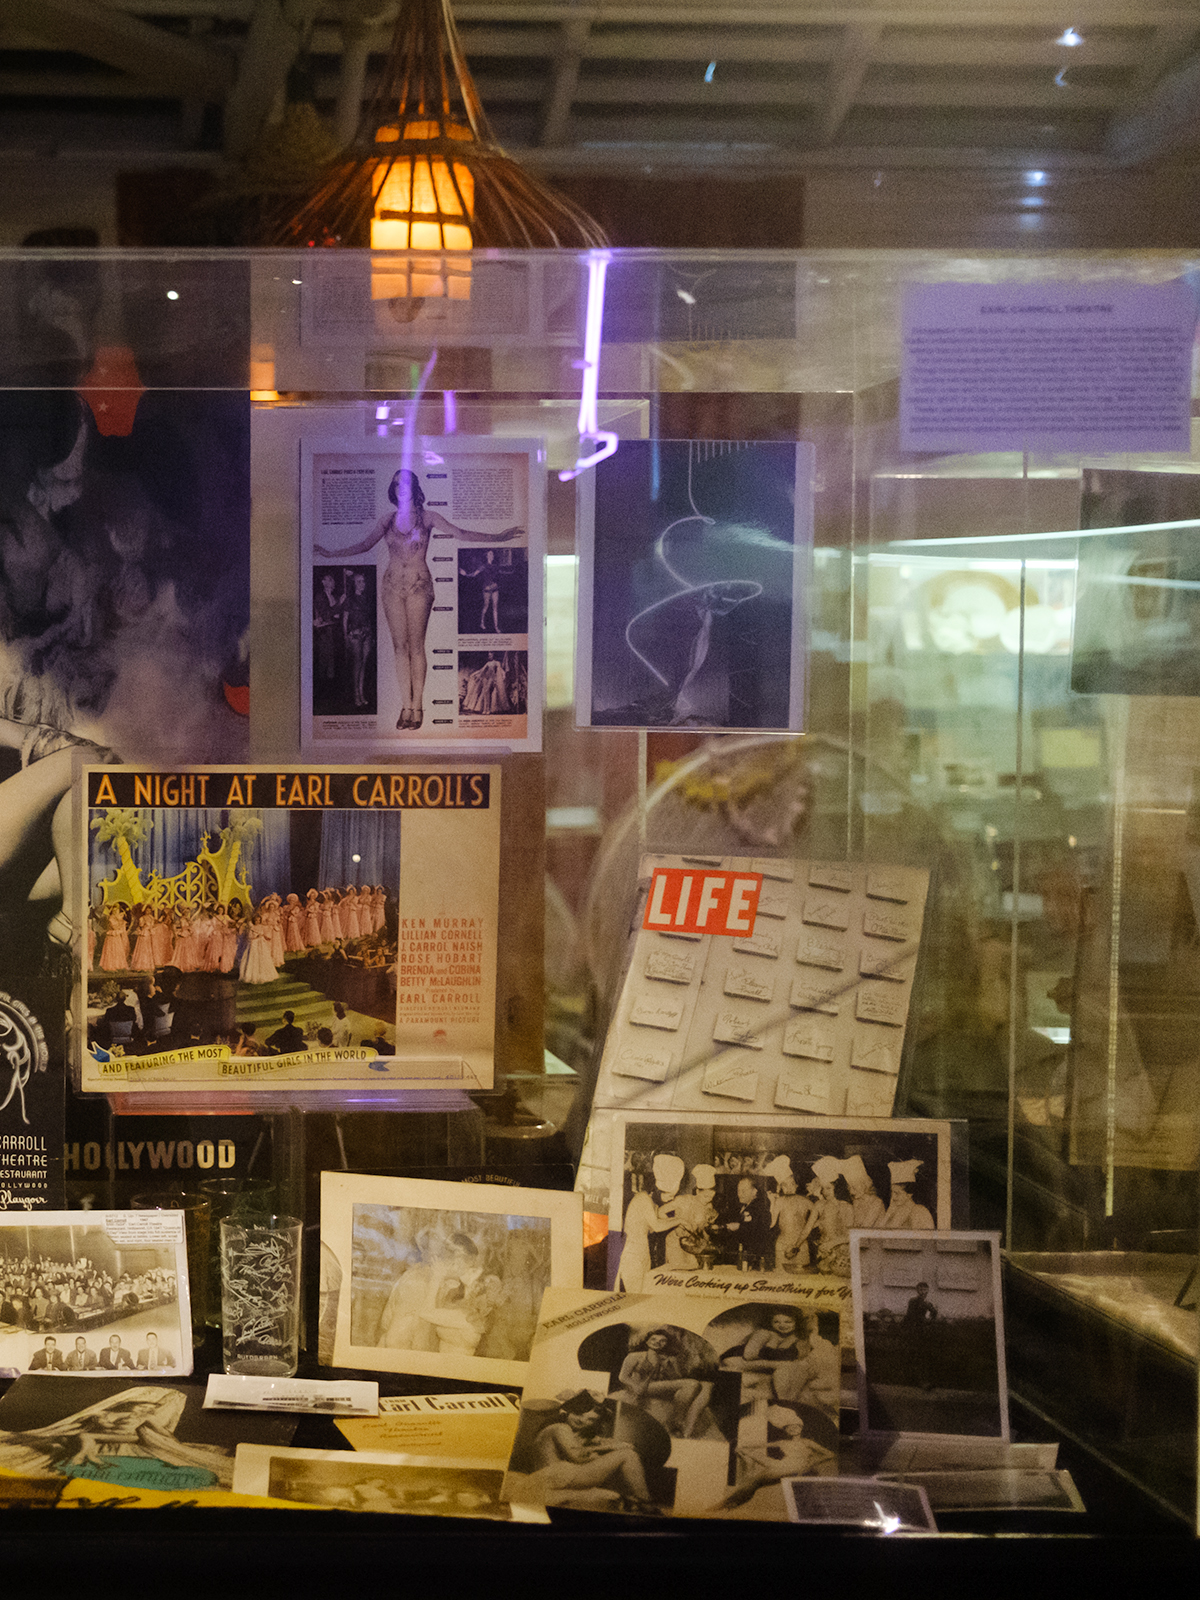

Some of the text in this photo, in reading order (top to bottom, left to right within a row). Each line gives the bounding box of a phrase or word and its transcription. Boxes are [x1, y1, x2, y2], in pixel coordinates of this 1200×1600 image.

[94, 774, 483, 807] A NIGHT AT EARL CARROLL'S
[648, 874, 758, 930] LIFE
[401, 918, 483, 929] KEN MURRAY
[401, 930, 483, 940] LILLIAN CORNELL
[409, 942, 448, 952] CARROL
[452, 942, 483, 952] NAISH
[400, 953, 482, 963] ROSE HOBART
[400, 965, 435, 975] BRENDA
[400, 977, 426, 987] BETTY
[400, 993, 481, 1003] EARL CARROLL
[11, 1000, 31, 1017] GIRLS
[27, 1016, 38, 1025] IN
[34, 1023, 45, 1039] THE
[38, 1041, 49, 1072] WORLD
[102, 1048, 223, 1074] AND FEATURING THE MOST
[222, 1050, 367, 1075] BEAUTIFUL GIRLS IN THE WORLD
[64, 1139, 236, 1170] HOLLYWOOD
[685, 1275, 732, 1293] Cooking
[733, 1283, 750, 1293] up
[750, 1280, 814, 1298] Something
[815, 1285, 836, 1299] for
[542, 1292, 627, 1329] EARL CARROLL
[566, 1305, 622, 1329] HOLLYWOOD
[424, 1396, 506, 1411] Carroll
